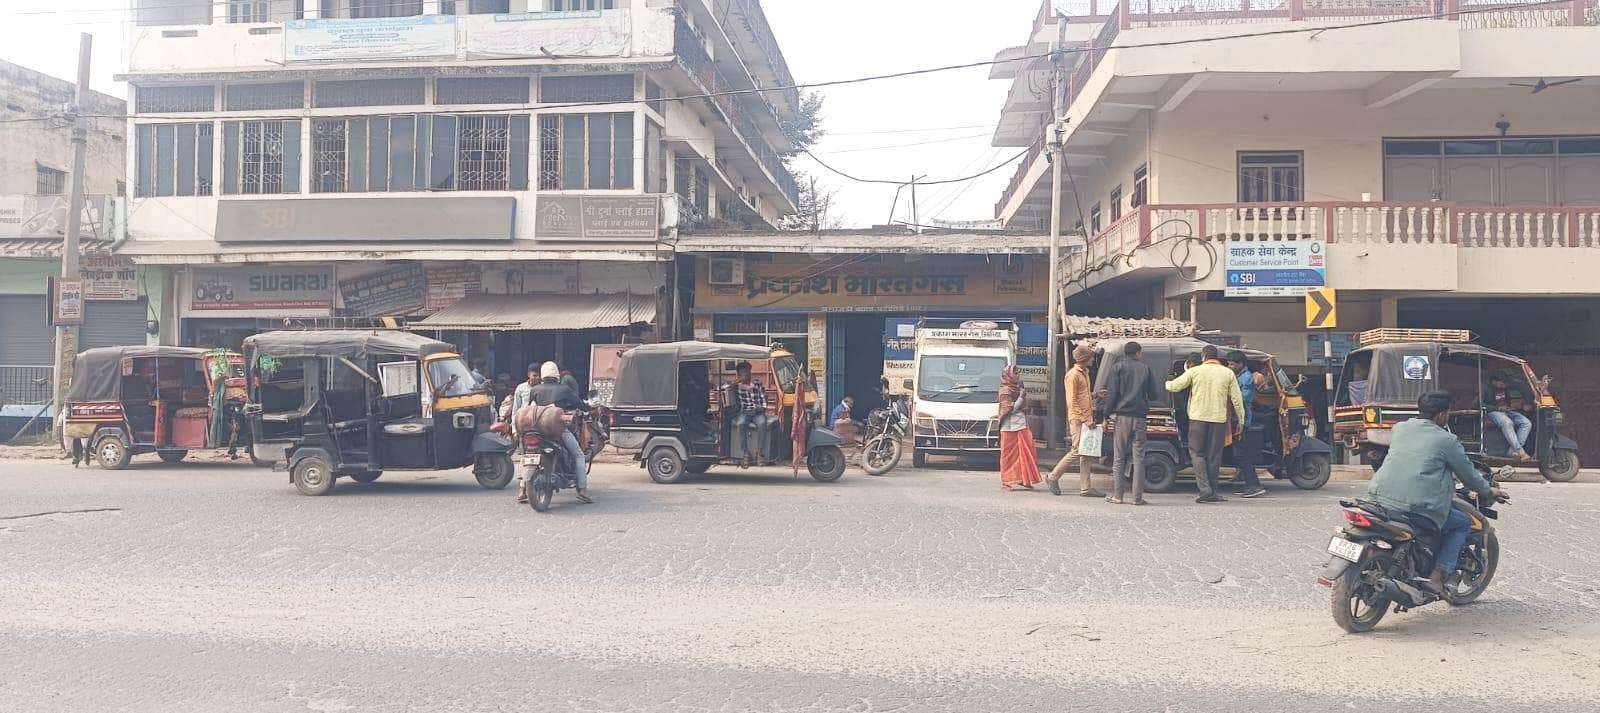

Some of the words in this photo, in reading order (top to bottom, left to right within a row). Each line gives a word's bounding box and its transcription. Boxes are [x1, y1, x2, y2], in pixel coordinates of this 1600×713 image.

[259, 207, 296, 229] SBI
[1230, 247, 1255, 257] ग्राहक
[1258, 245, 1275, 257] सेवा
[1278, 244, 1297, 257] केन्द्र
[1260, 259, 1282, 267] Service
[1239, 272, 1256, 284] SBI
[746, 273, 840, 299] प्रकाश
